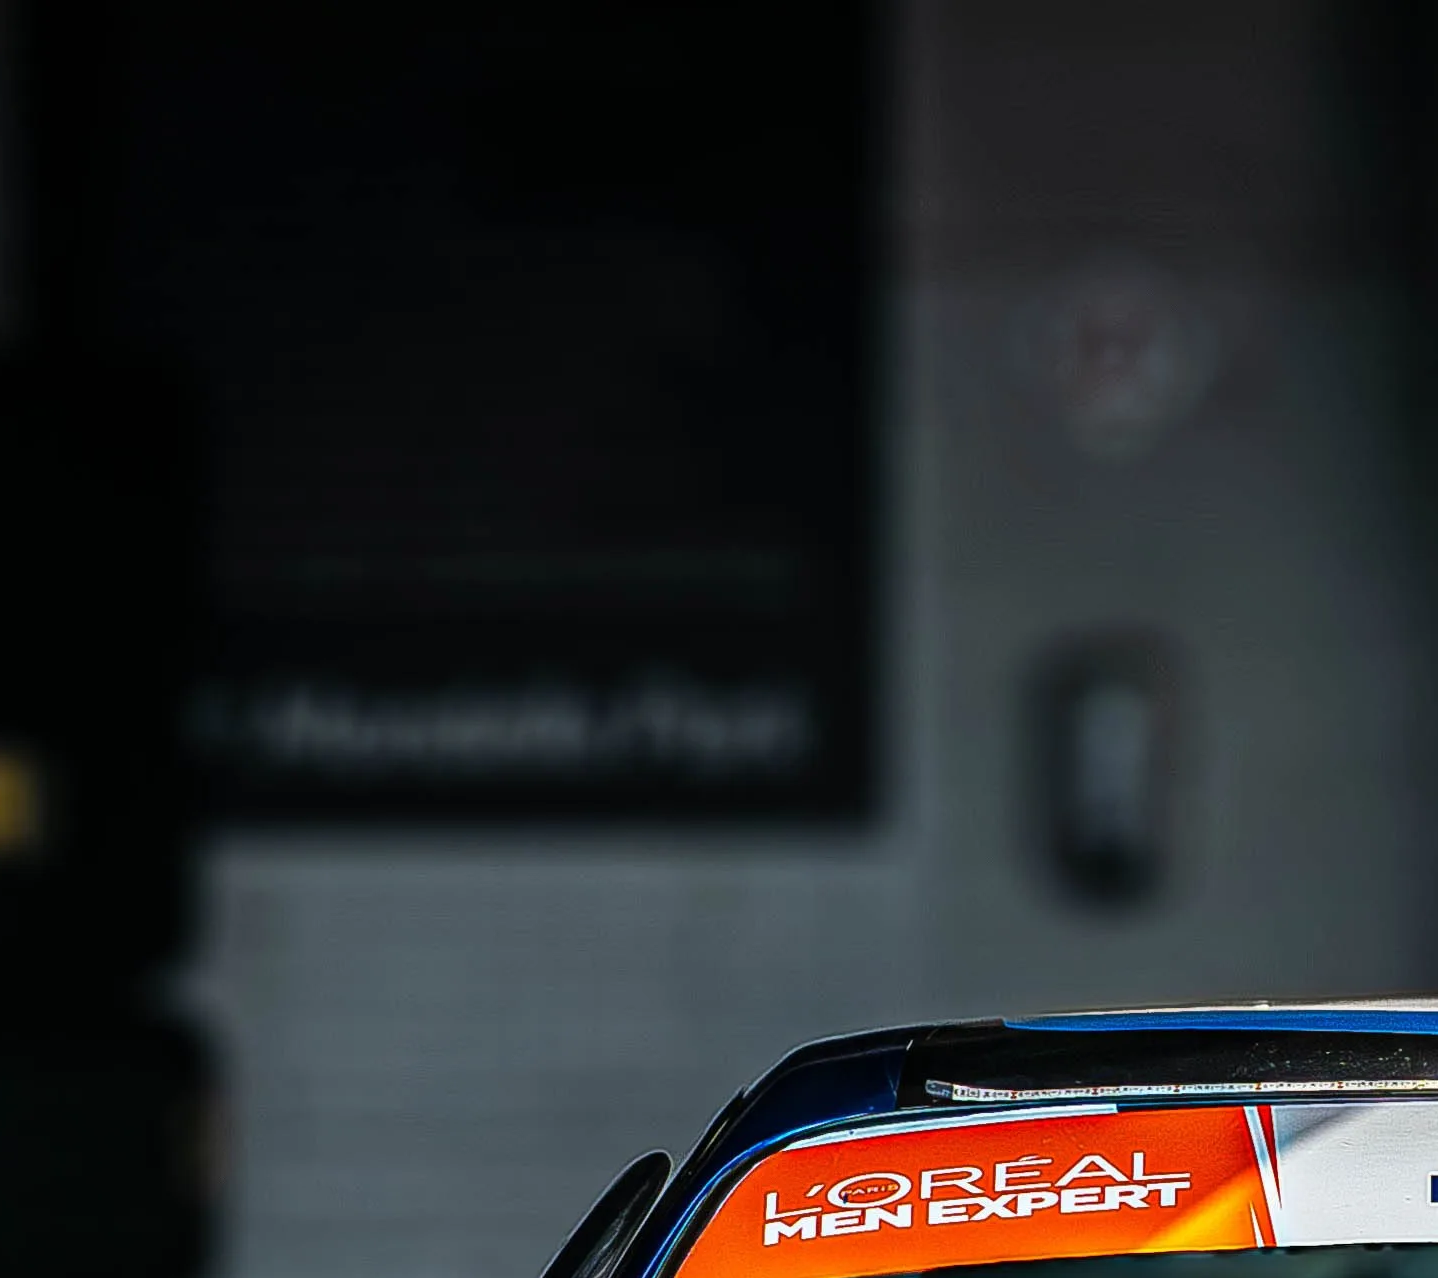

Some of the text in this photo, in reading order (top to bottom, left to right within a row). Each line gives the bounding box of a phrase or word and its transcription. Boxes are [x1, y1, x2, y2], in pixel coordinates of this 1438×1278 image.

[762, 1180, 1192, 1247] MEN EXPERT
[763, 1151, 1192, 1220] L'ORÉAL
